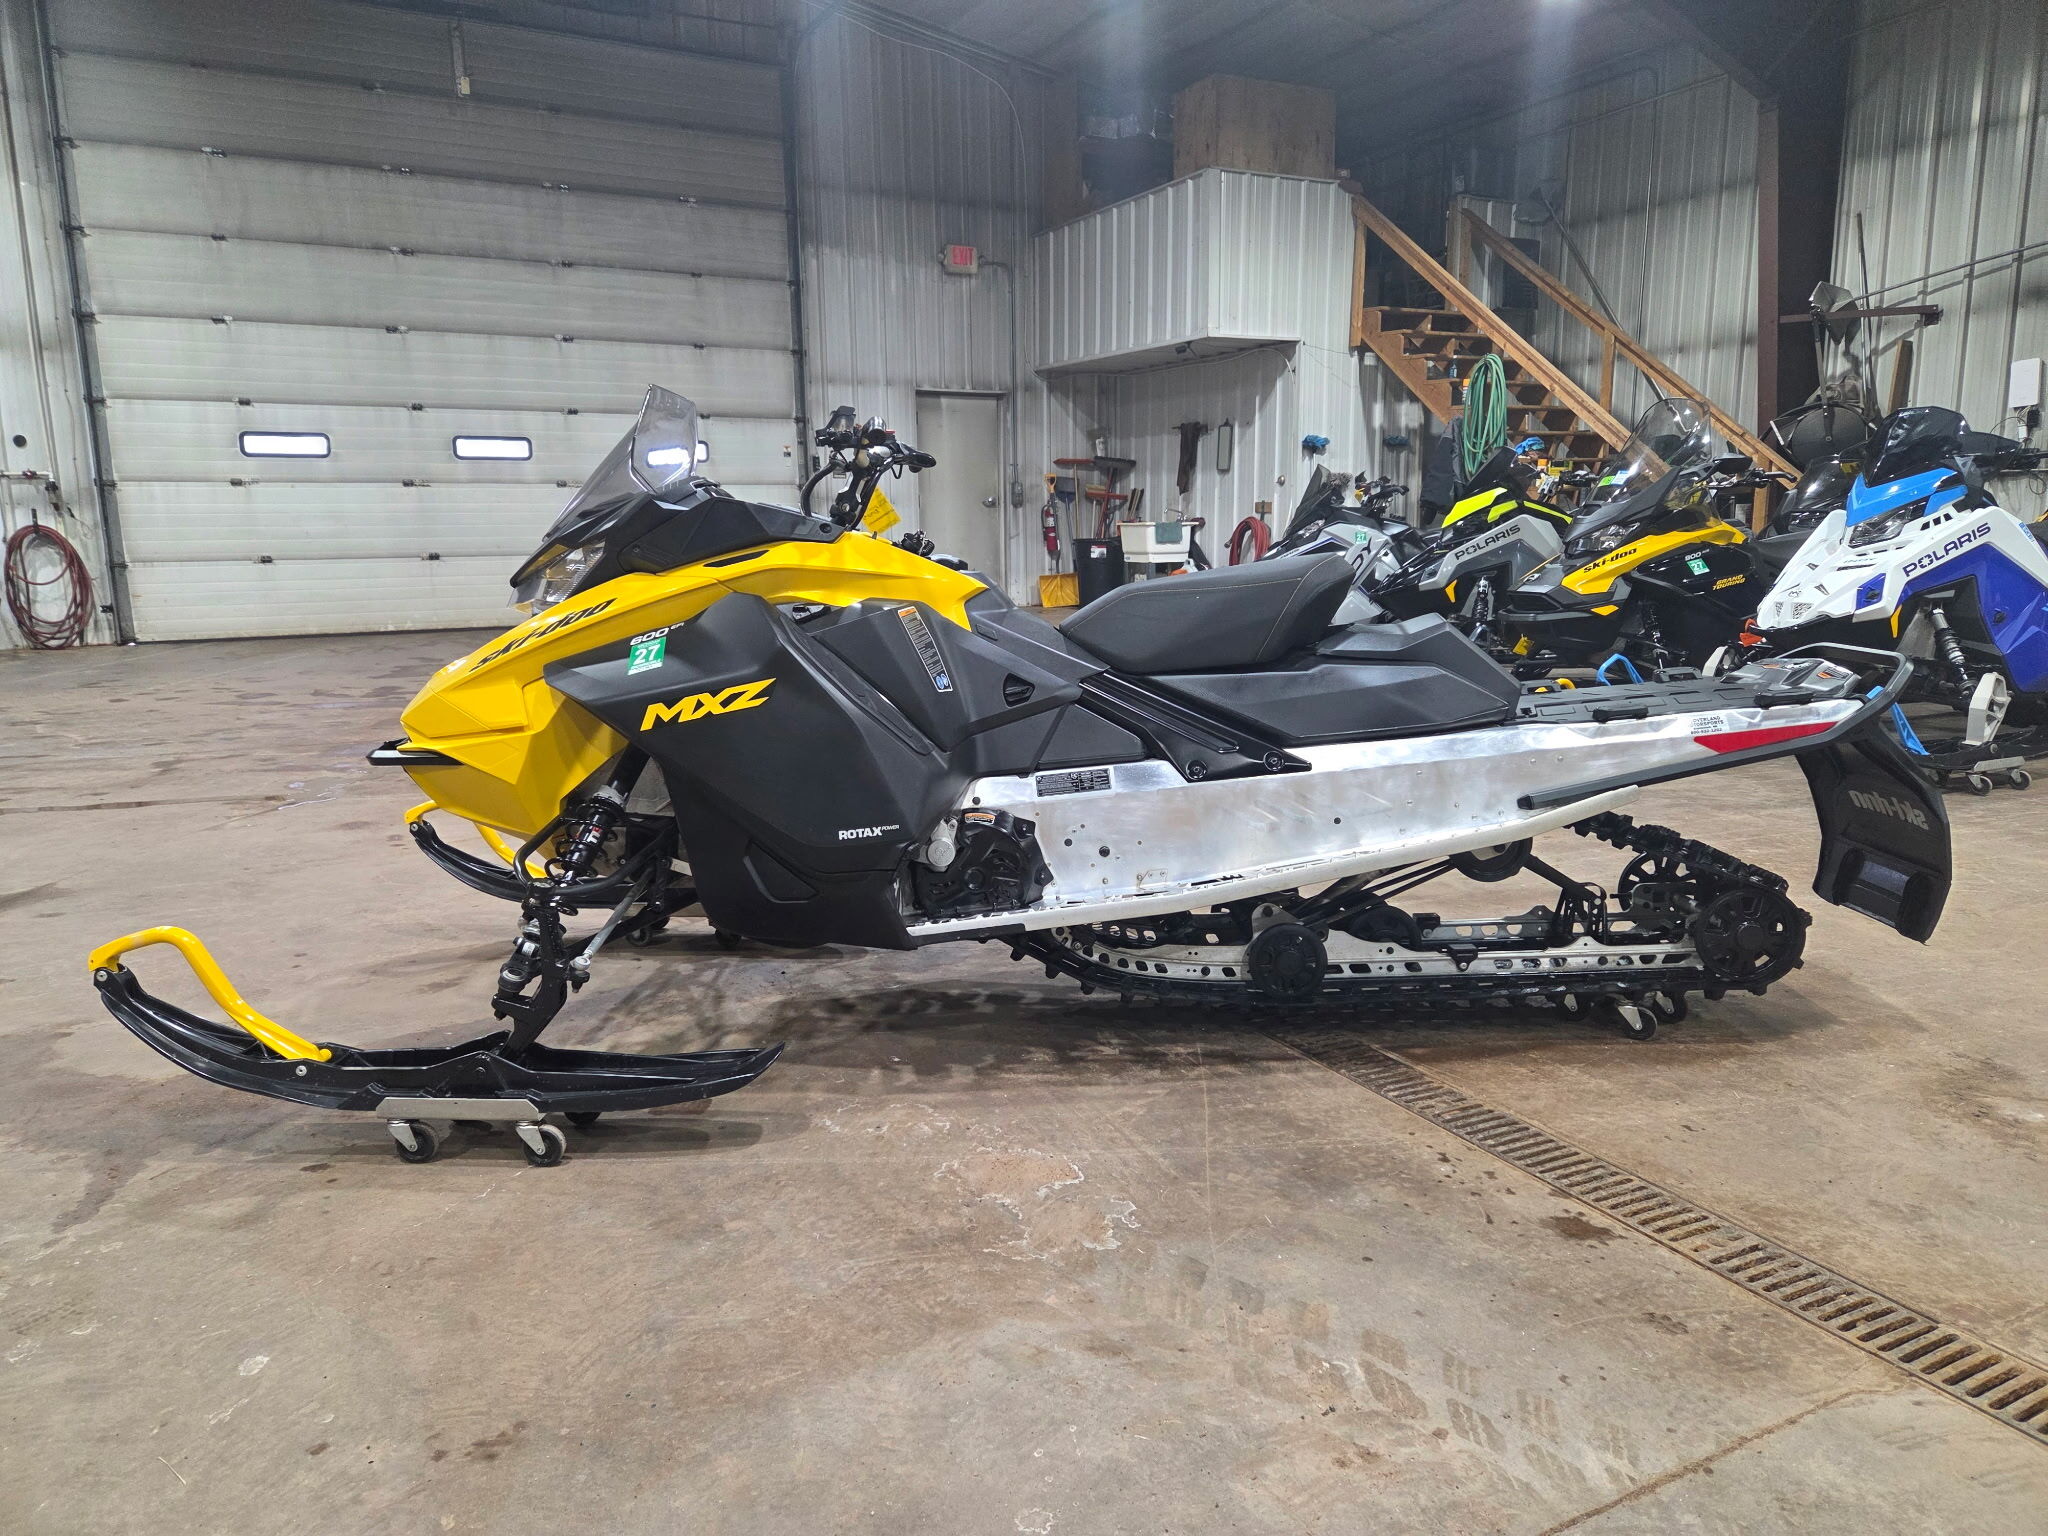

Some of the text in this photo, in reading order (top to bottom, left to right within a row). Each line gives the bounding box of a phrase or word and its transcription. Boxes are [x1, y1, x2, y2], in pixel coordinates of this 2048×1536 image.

[952, 247, 973, 265] EXIT
[1455, 524, 1521, 560] POLARIS
[1902, 522, 1991, 577] POLARIS
[1584, 548, 1637, 573] ski-doo
[1691, 562, 1703, 571] 27
[1713, 578, 1746, 590] TOURING
[1717, 574, 1744, 585] GRAND
[469, 598, 618, 673] ski-doo
[630, 628, 669, 646] 600
[633, 644, 661, 666] 27
[640, 678, 777, 732] MXZ
[838, 827, 882, 840] ROTAX
